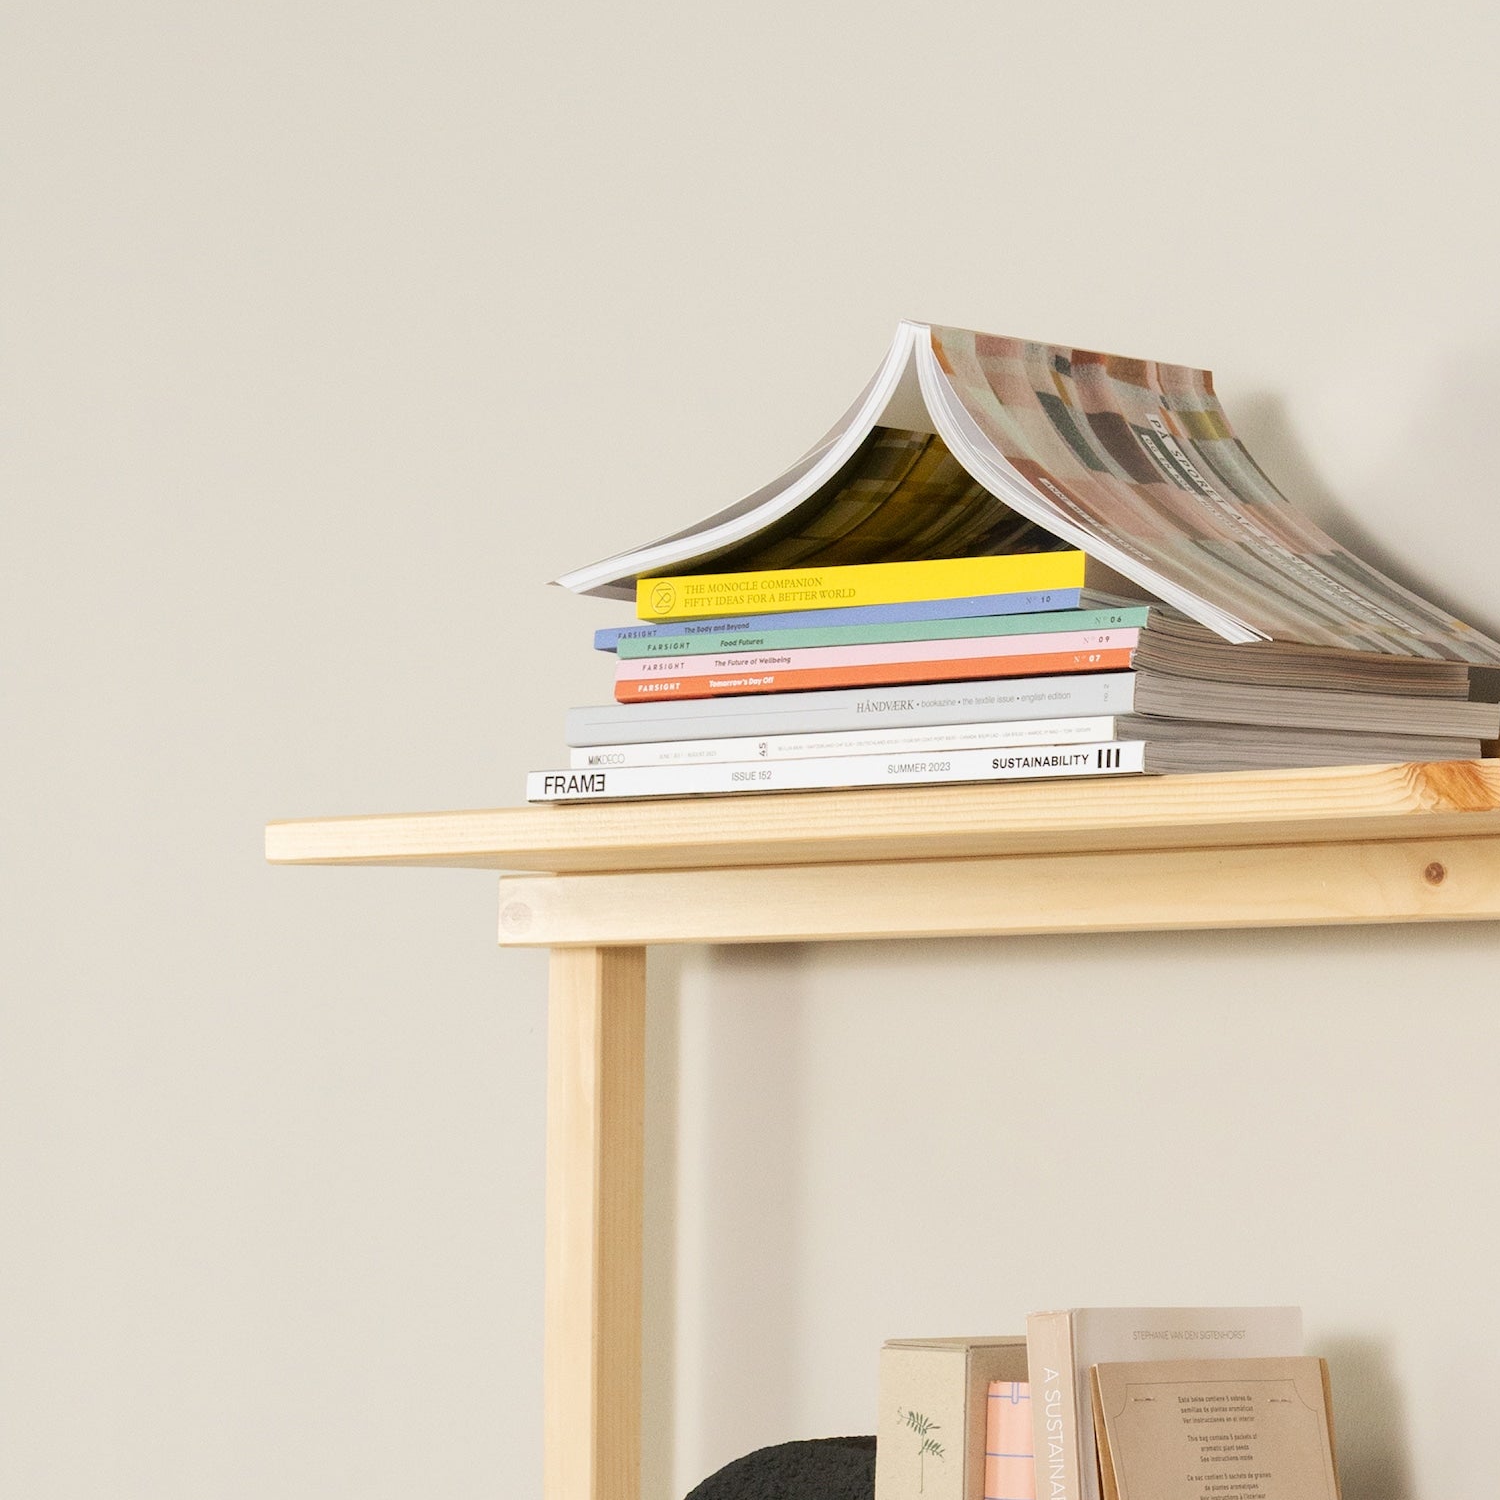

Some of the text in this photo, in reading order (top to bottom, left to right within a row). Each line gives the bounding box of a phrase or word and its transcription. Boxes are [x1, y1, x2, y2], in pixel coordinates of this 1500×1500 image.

[684, 577, 823, 595] THE MONOCLE COMPANION
[684, 588, 856, 608] FIFTY IDEAS FOR A BETTER WORLD
[1041, 595, 1051, 603] 10
[618, 630, 657, 639] FARSIGHT
[684, 626, 696, 634] The
[696, 625, 713, 634] Body
[726, 622, 750, 632] Beyond
[647, 638, 764, 651] FARSIGHT Food Futures
[1098, 635, 1110, 643] 09
[642, 656, 792, 672] FARSIGHT The Future of Wellbeing
[1089, 654, 1101, 662] 07
[638, 682, 681, 692] FARSIGHT
[749, 677, 762, 687] Day
[762, 676, 775, 685] Off
[857, 691, 1071, 713] HÅNDVÆRK bookazine the textile issue english edition
[731, 771, 756, 781] ISSUE
[758, 770, 772, 780] 152
[887, 762, 927, 774] SUMMER
[928, 761, 951, 772] 2023
[992, 754, 1089, 769] SUSTAINABILITY
[1044, 1368, 1058, 1383] A
